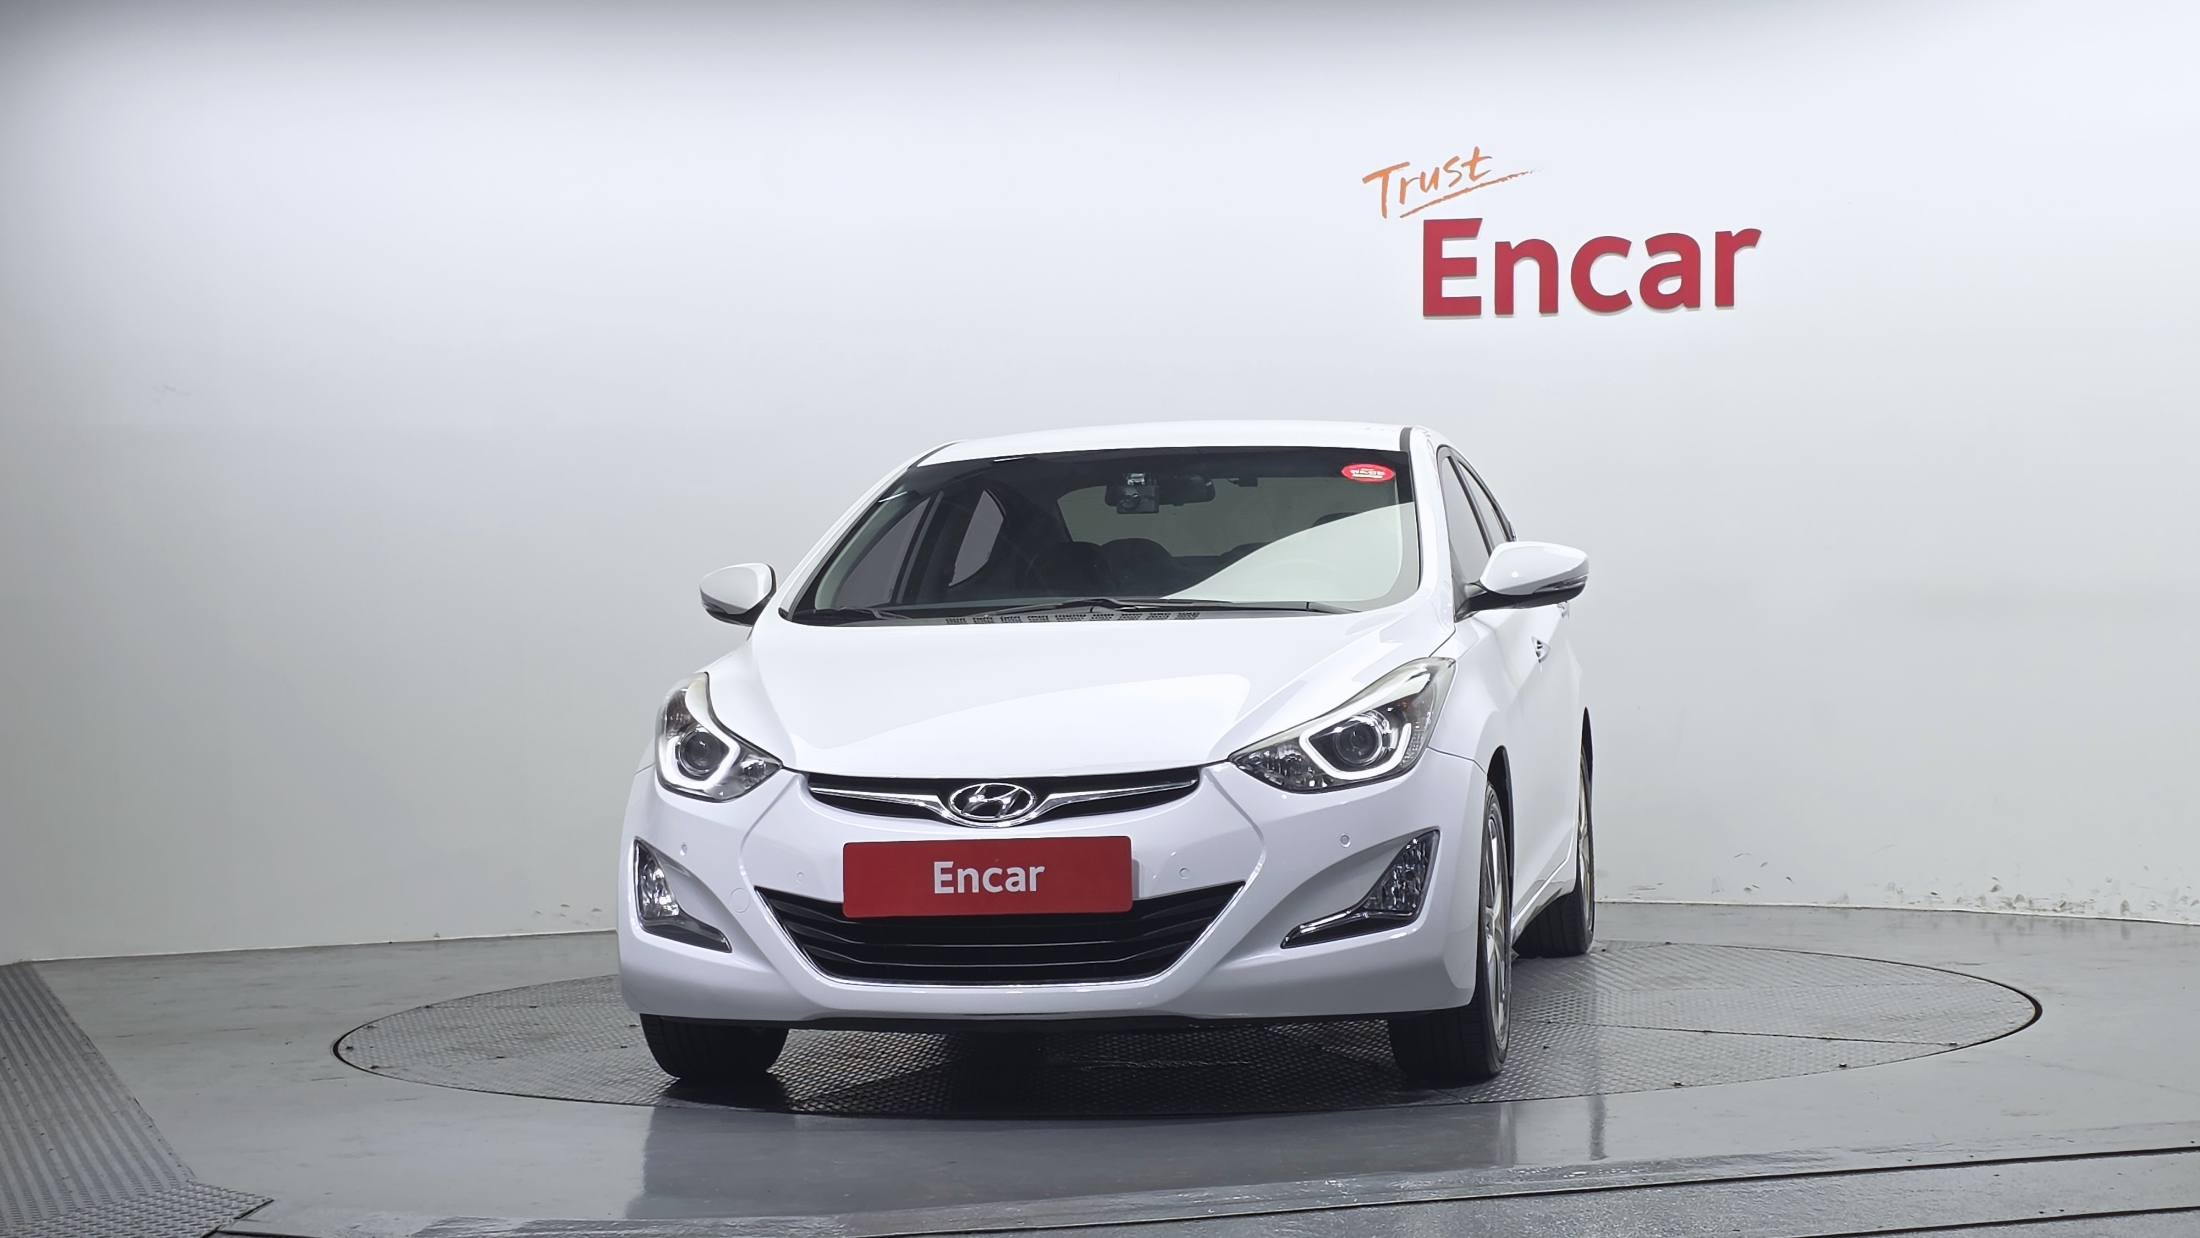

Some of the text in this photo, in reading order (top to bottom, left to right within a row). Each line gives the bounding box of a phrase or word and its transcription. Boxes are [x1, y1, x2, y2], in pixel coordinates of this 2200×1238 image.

[1362, 146, 1493, 219] Trust
[1422, 217, 1762, 318] Encar
[934, 861, 1045, 894] Encar
